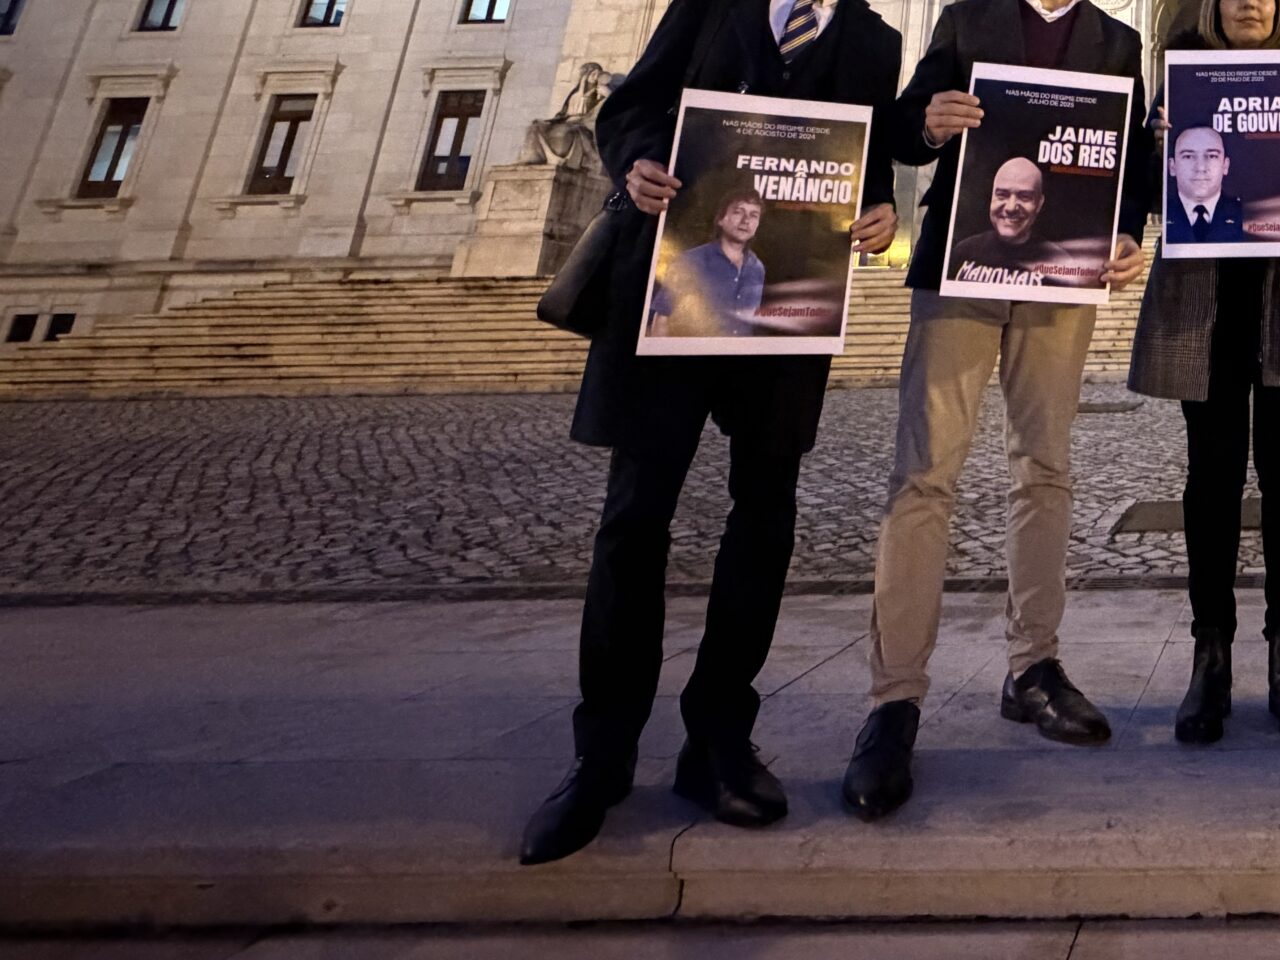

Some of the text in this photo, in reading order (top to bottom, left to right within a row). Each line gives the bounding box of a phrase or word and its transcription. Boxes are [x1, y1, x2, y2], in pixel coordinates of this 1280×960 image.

[1051, 94, 1075, 102] REGIME
[722, 119, 739, 127] NAS
[776, 124, 804, 133] REGIME
[806, 126, 830, 135] DESDE
[1213, 113, 1233, 133] DE
[754, 129, 786, 138] AGOSTO
[1048, 125, 1117, 146] JAIME
[1038, 140, 1117, 169] DOS REIS
[736, 154, 856, 176] FERNANDO
[754, 171, 852, 204] VENÂNCIO
